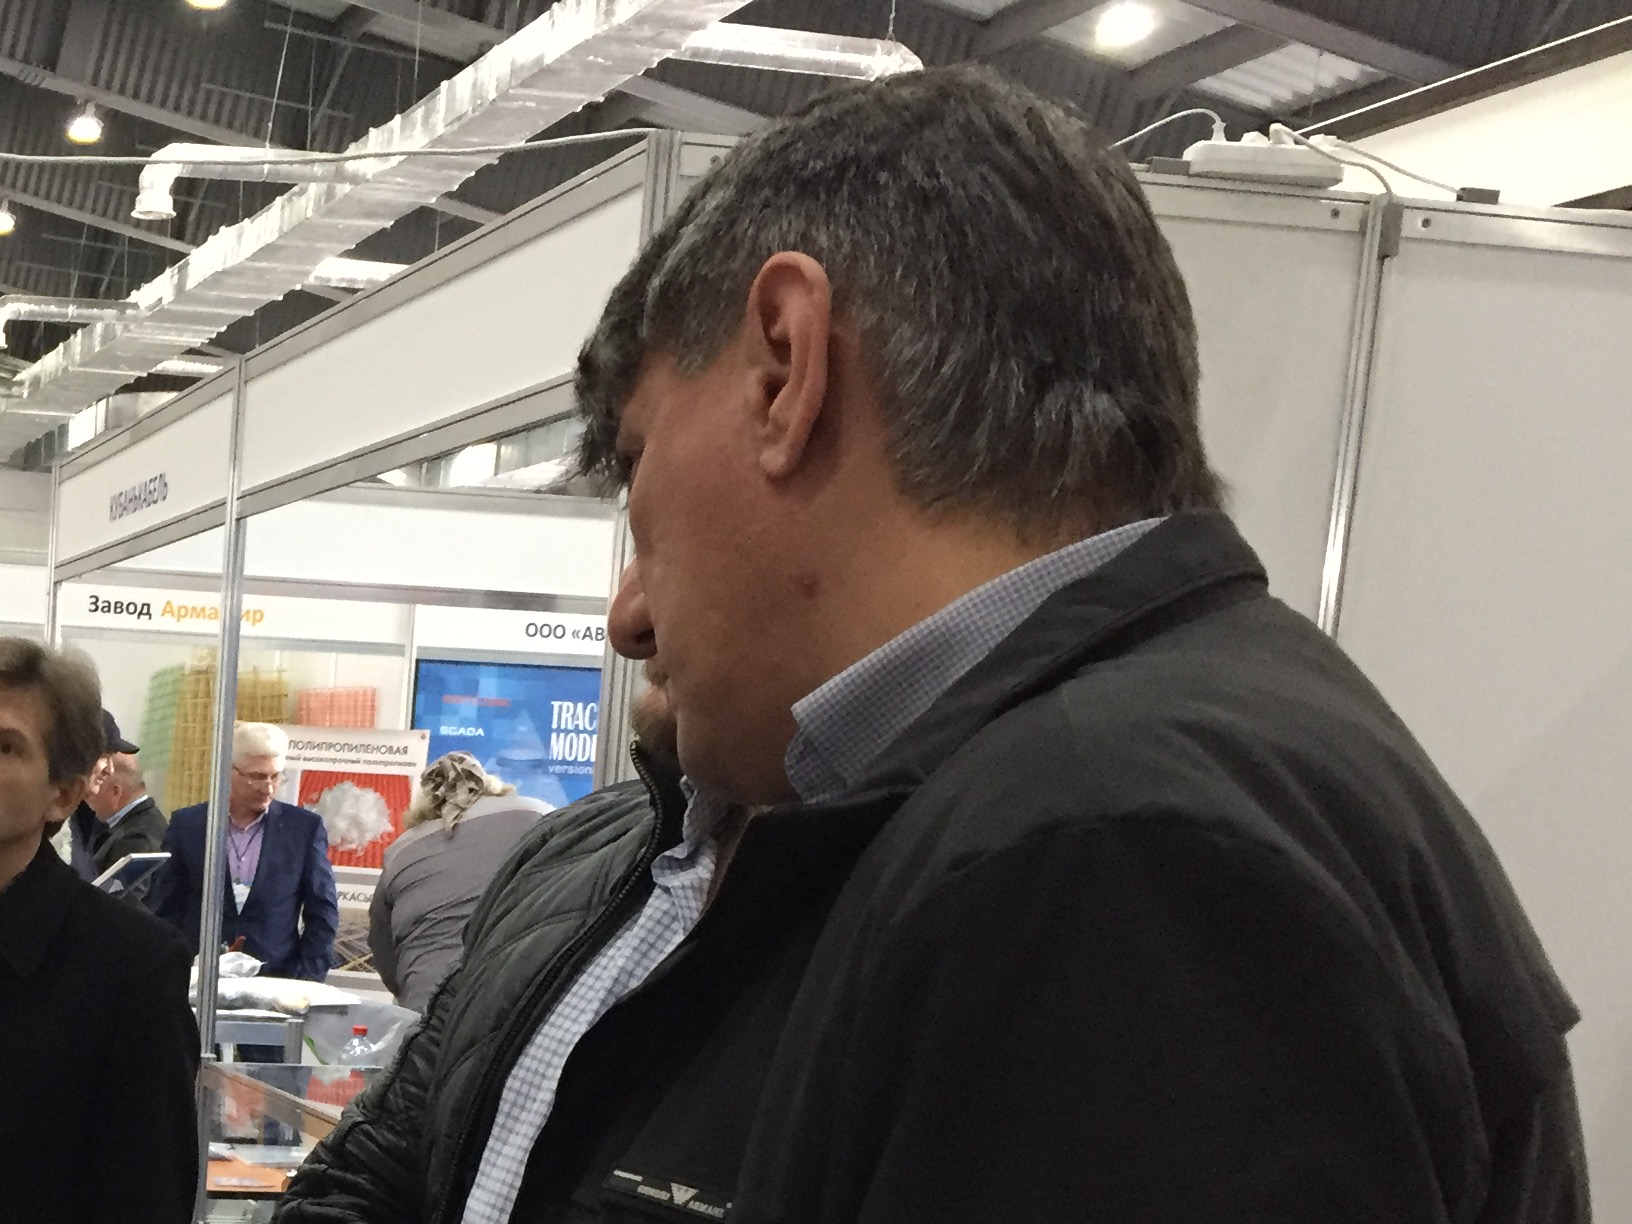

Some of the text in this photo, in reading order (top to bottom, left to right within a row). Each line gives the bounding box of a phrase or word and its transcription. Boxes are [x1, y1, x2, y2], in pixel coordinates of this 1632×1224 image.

[88, 594, 265, 627] Завод Армаир
[525, 622, 567, 640] ООО
[288, 739, 409, 756] ПОЛИПРОПИЛЕНОВАЯ
